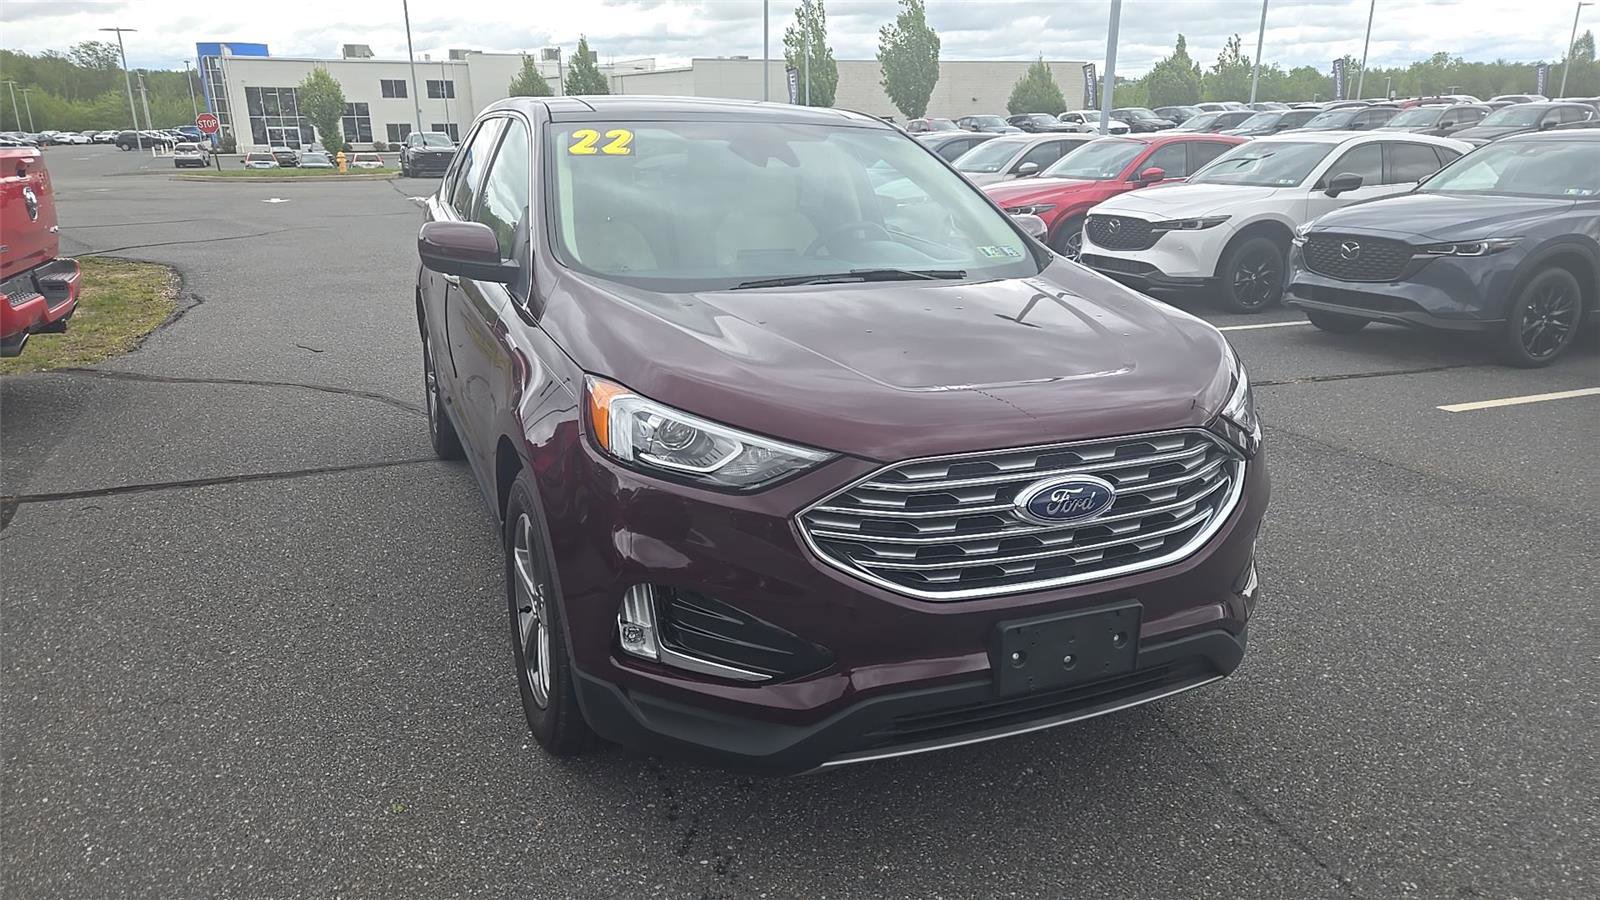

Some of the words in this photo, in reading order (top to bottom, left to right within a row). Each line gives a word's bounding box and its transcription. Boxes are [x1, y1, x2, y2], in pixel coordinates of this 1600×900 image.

[198, 119, 217, 129] STOP
[568, 129, 634, 155] 22
[1046, 487, 1097, 515] Ford
